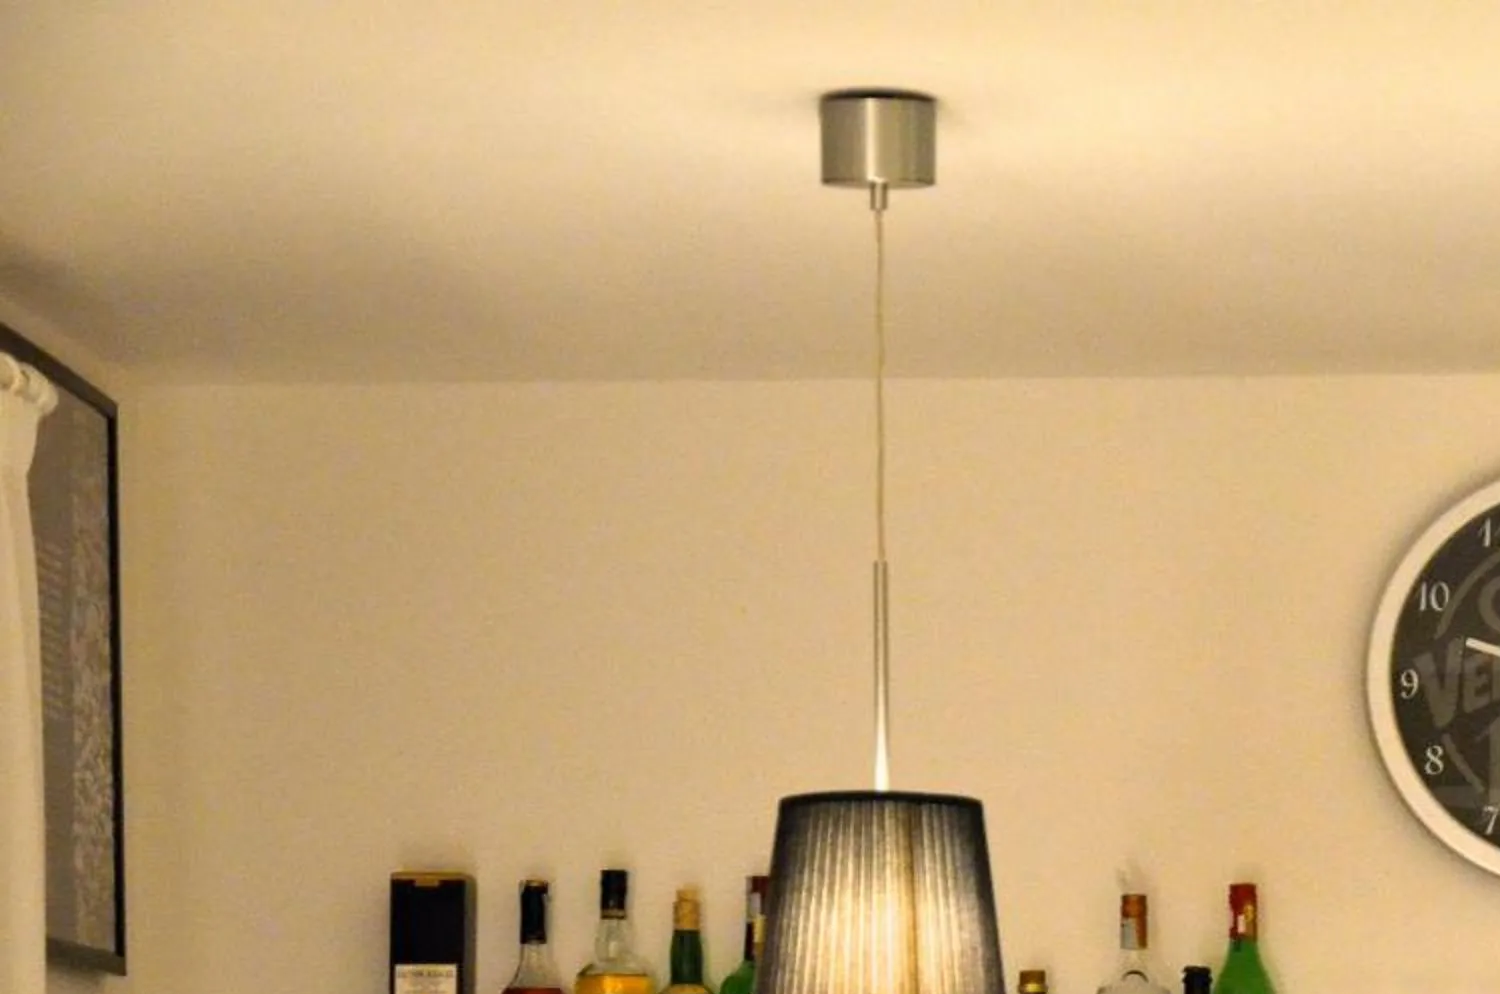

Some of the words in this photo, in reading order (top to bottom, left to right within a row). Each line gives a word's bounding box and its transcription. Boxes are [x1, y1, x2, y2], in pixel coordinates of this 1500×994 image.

[1419, 581, 1450, 611] 10
[1401, 670, 1419, 698] 9
[1424, 745, 1444, 775] 8
[1483, 806, 1499, 835] 7
